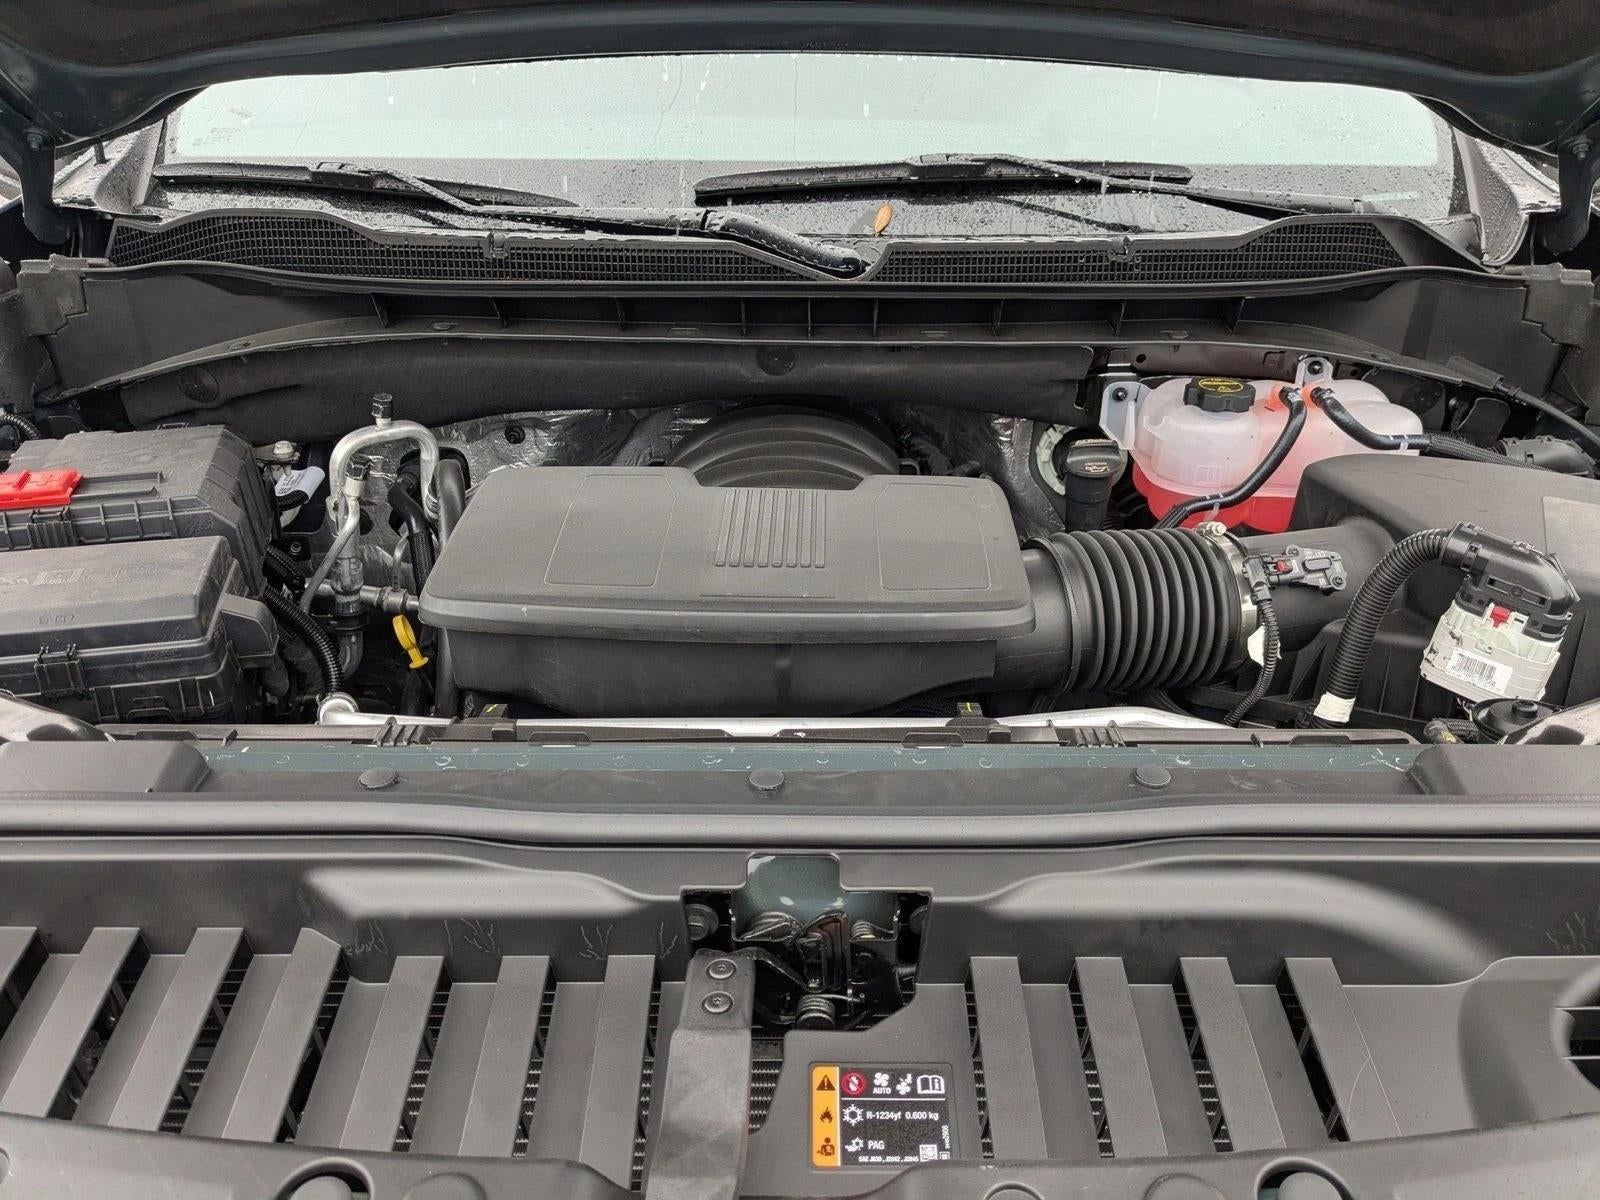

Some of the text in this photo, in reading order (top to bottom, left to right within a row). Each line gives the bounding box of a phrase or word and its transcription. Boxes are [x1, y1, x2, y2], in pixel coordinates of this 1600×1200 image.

[866, 1111, 939, 1121] R-1234yf 0.600 kg
[868, 1140, 885, 1150] PAG
